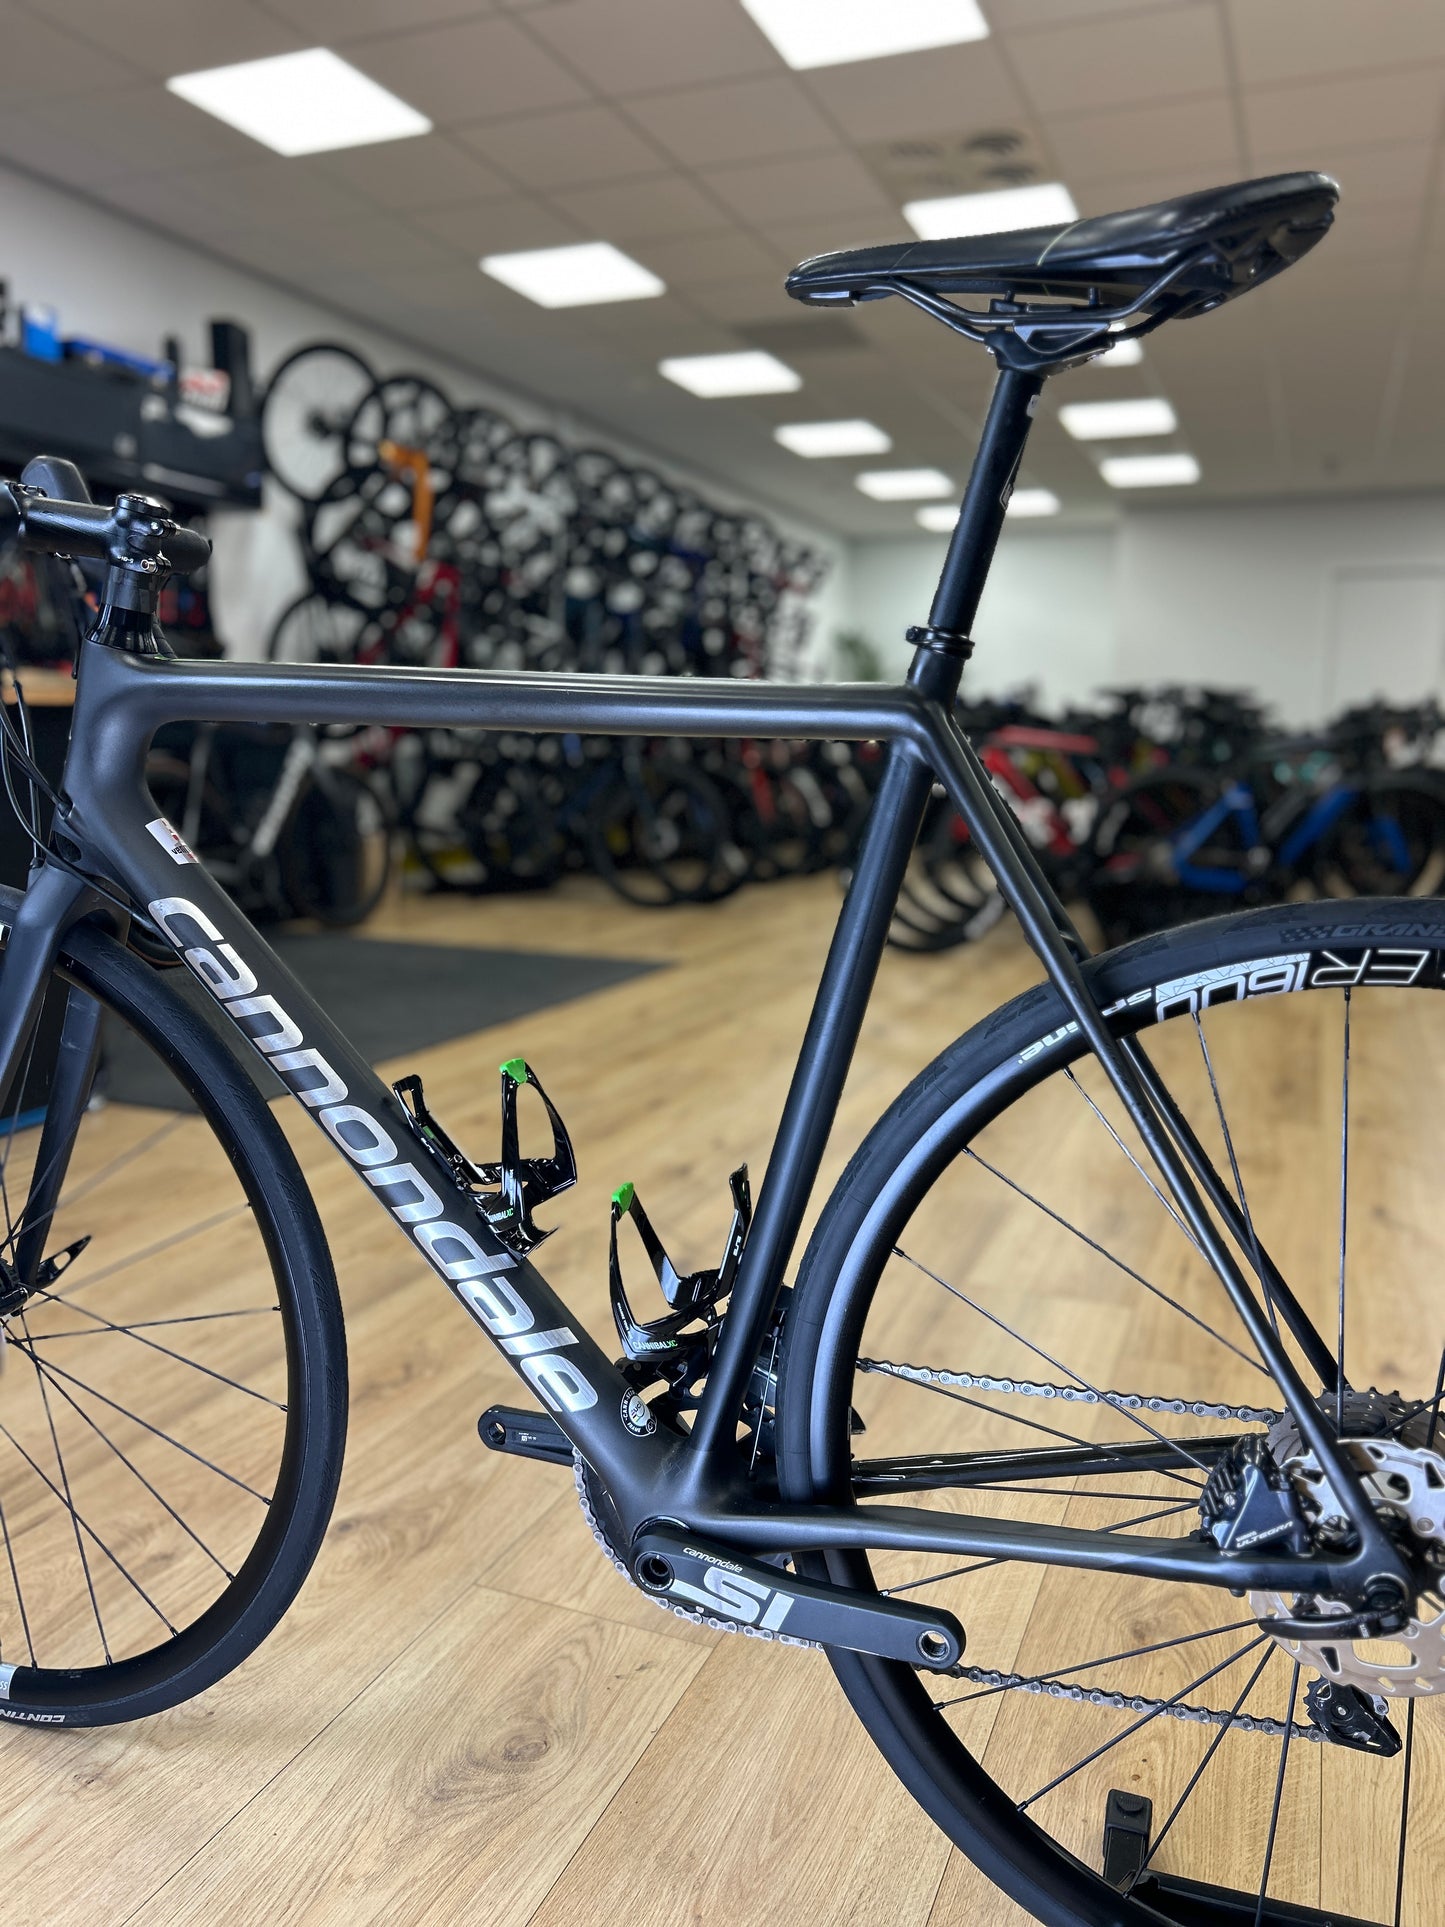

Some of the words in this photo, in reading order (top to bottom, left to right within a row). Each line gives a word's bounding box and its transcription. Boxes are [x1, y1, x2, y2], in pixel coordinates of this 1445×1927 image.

[1311, 948, 1430, 986] ER
[148, 896, 599, 1412] cannondale
[1236, 1520, 1294, 1548] ULTEGRA
[682, 1546, 743, 1574] cannondale
